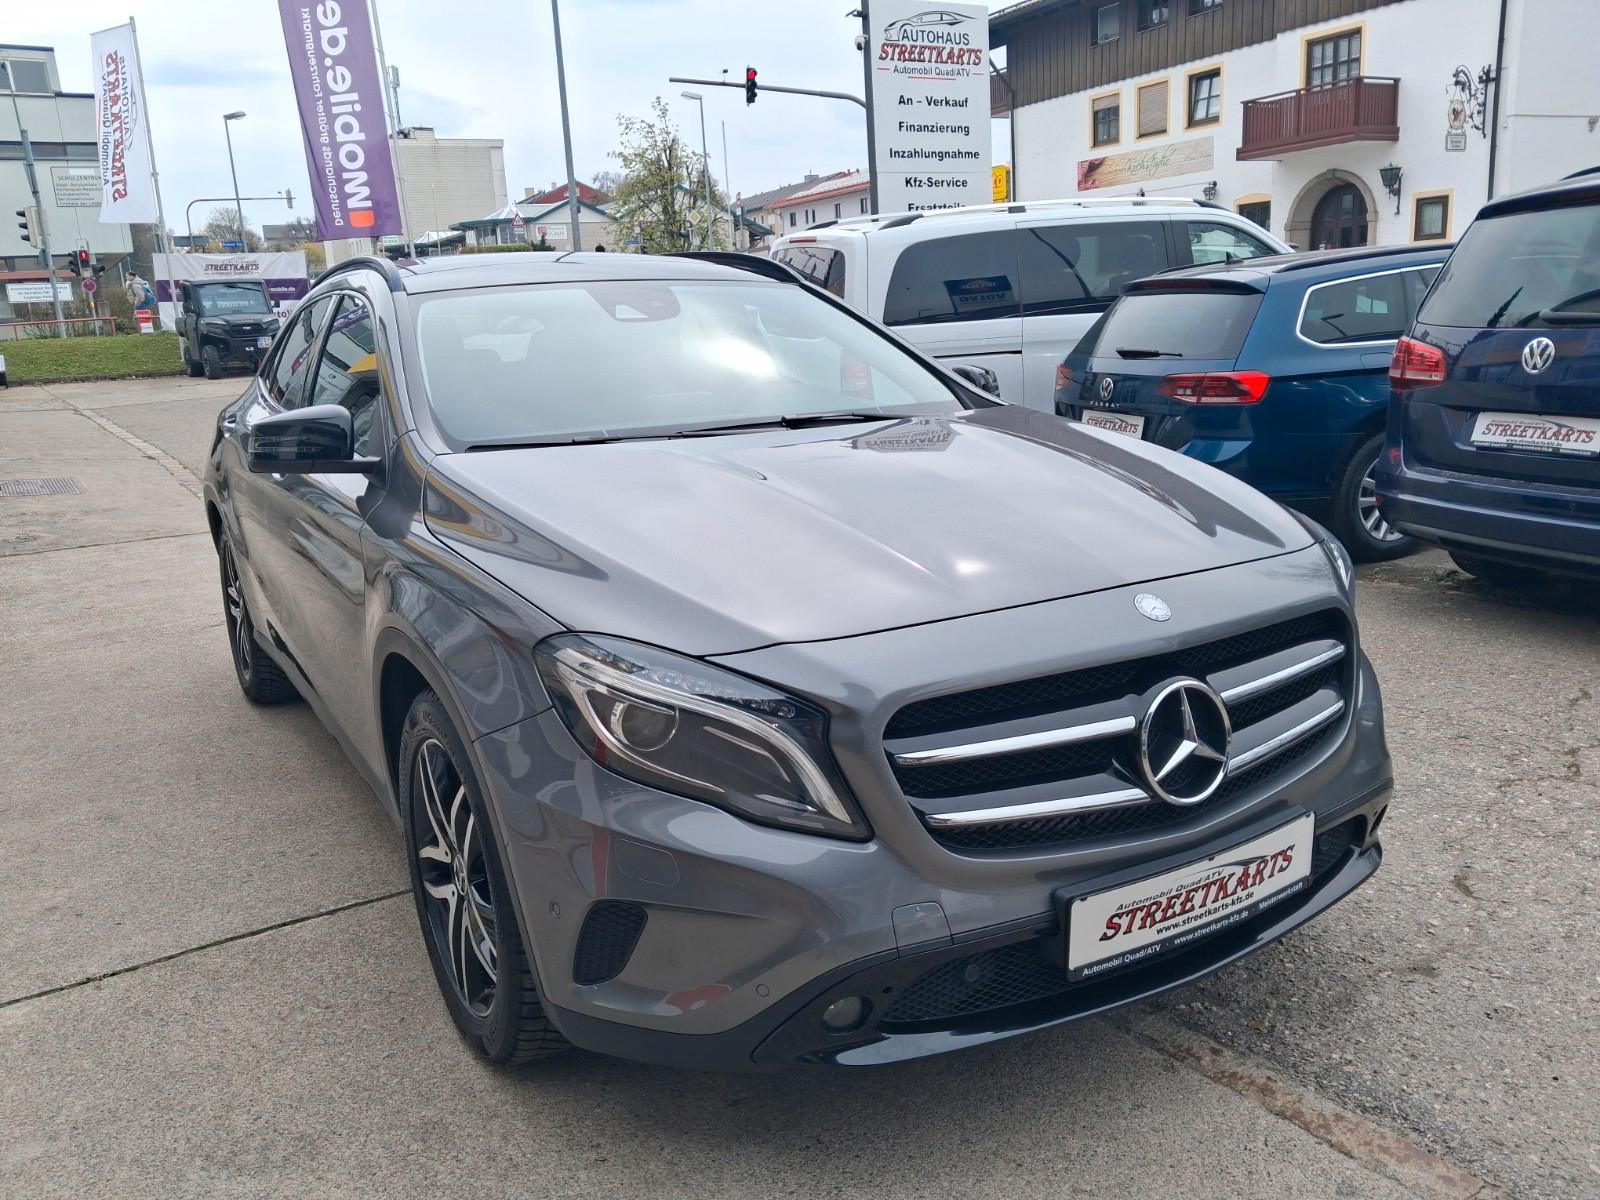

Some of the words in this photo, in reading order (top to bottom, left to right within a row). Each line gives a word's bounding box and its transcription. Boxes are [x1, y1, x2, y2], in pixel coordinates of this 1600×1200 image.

[901, 29, 970, 45] AUTOHAUS
[878, 43, 983, 66] STREETKARTS
[893, 65, 933, 75] Automobil
[934, 67, 971, 77] Quad/ATV
[898, 95, 913, 106] An
[925, 96, 969, 107] Verkauf
[898, 121, 970, 136] Finanzierung
[889, 148, 980, 161] Inzahlungnahme
[905, 177, 968, 188] Kfz-Service
[204, 263, 260, 272] STREETKARTS
[1086, 418, 1140, 434] STREETKARTS
[1482, 423, 1597, 444] STREETKARTS
[1099, 843, 1296, 942] STREETKARTS
[1115, 887, 1174, 912] Automobil
[1175, 869, 1225, 893] Quad/ATV
[1156, 890, 1255, 935] www.streetkarts-kfz.de
[1082, 955, 1123, 977] Automobil
[1124, 943, 1161, 963] Quad/ATV
[1174, 910, 1249, 945] www.streetkarts-kfz.de
[1259, 882, 1303, 910] Meisterwerkstatt
